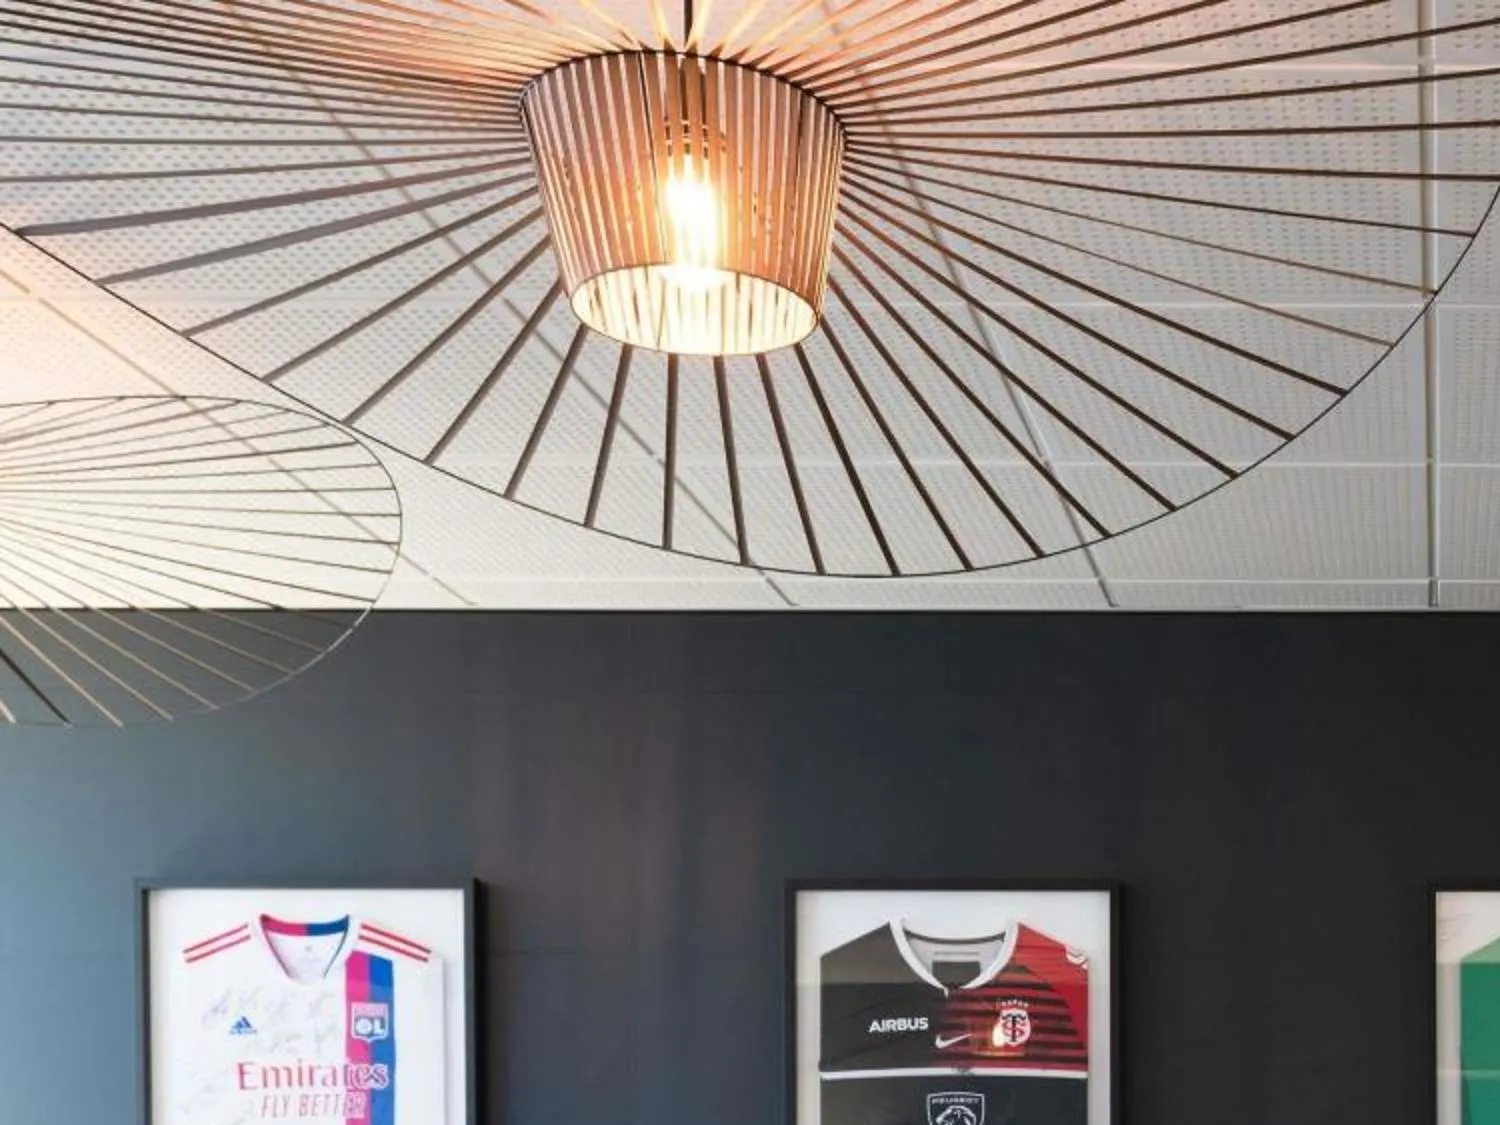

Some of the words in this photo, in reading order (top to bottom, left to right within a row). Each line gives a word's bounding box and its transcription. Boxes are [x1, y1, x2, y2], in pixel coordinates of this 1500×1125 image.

[868, 1017, 929, 1033] AIRBUS
[236, 1059, 389, 1090] Emirates
[261, 1094, 291, 1118] FLY
